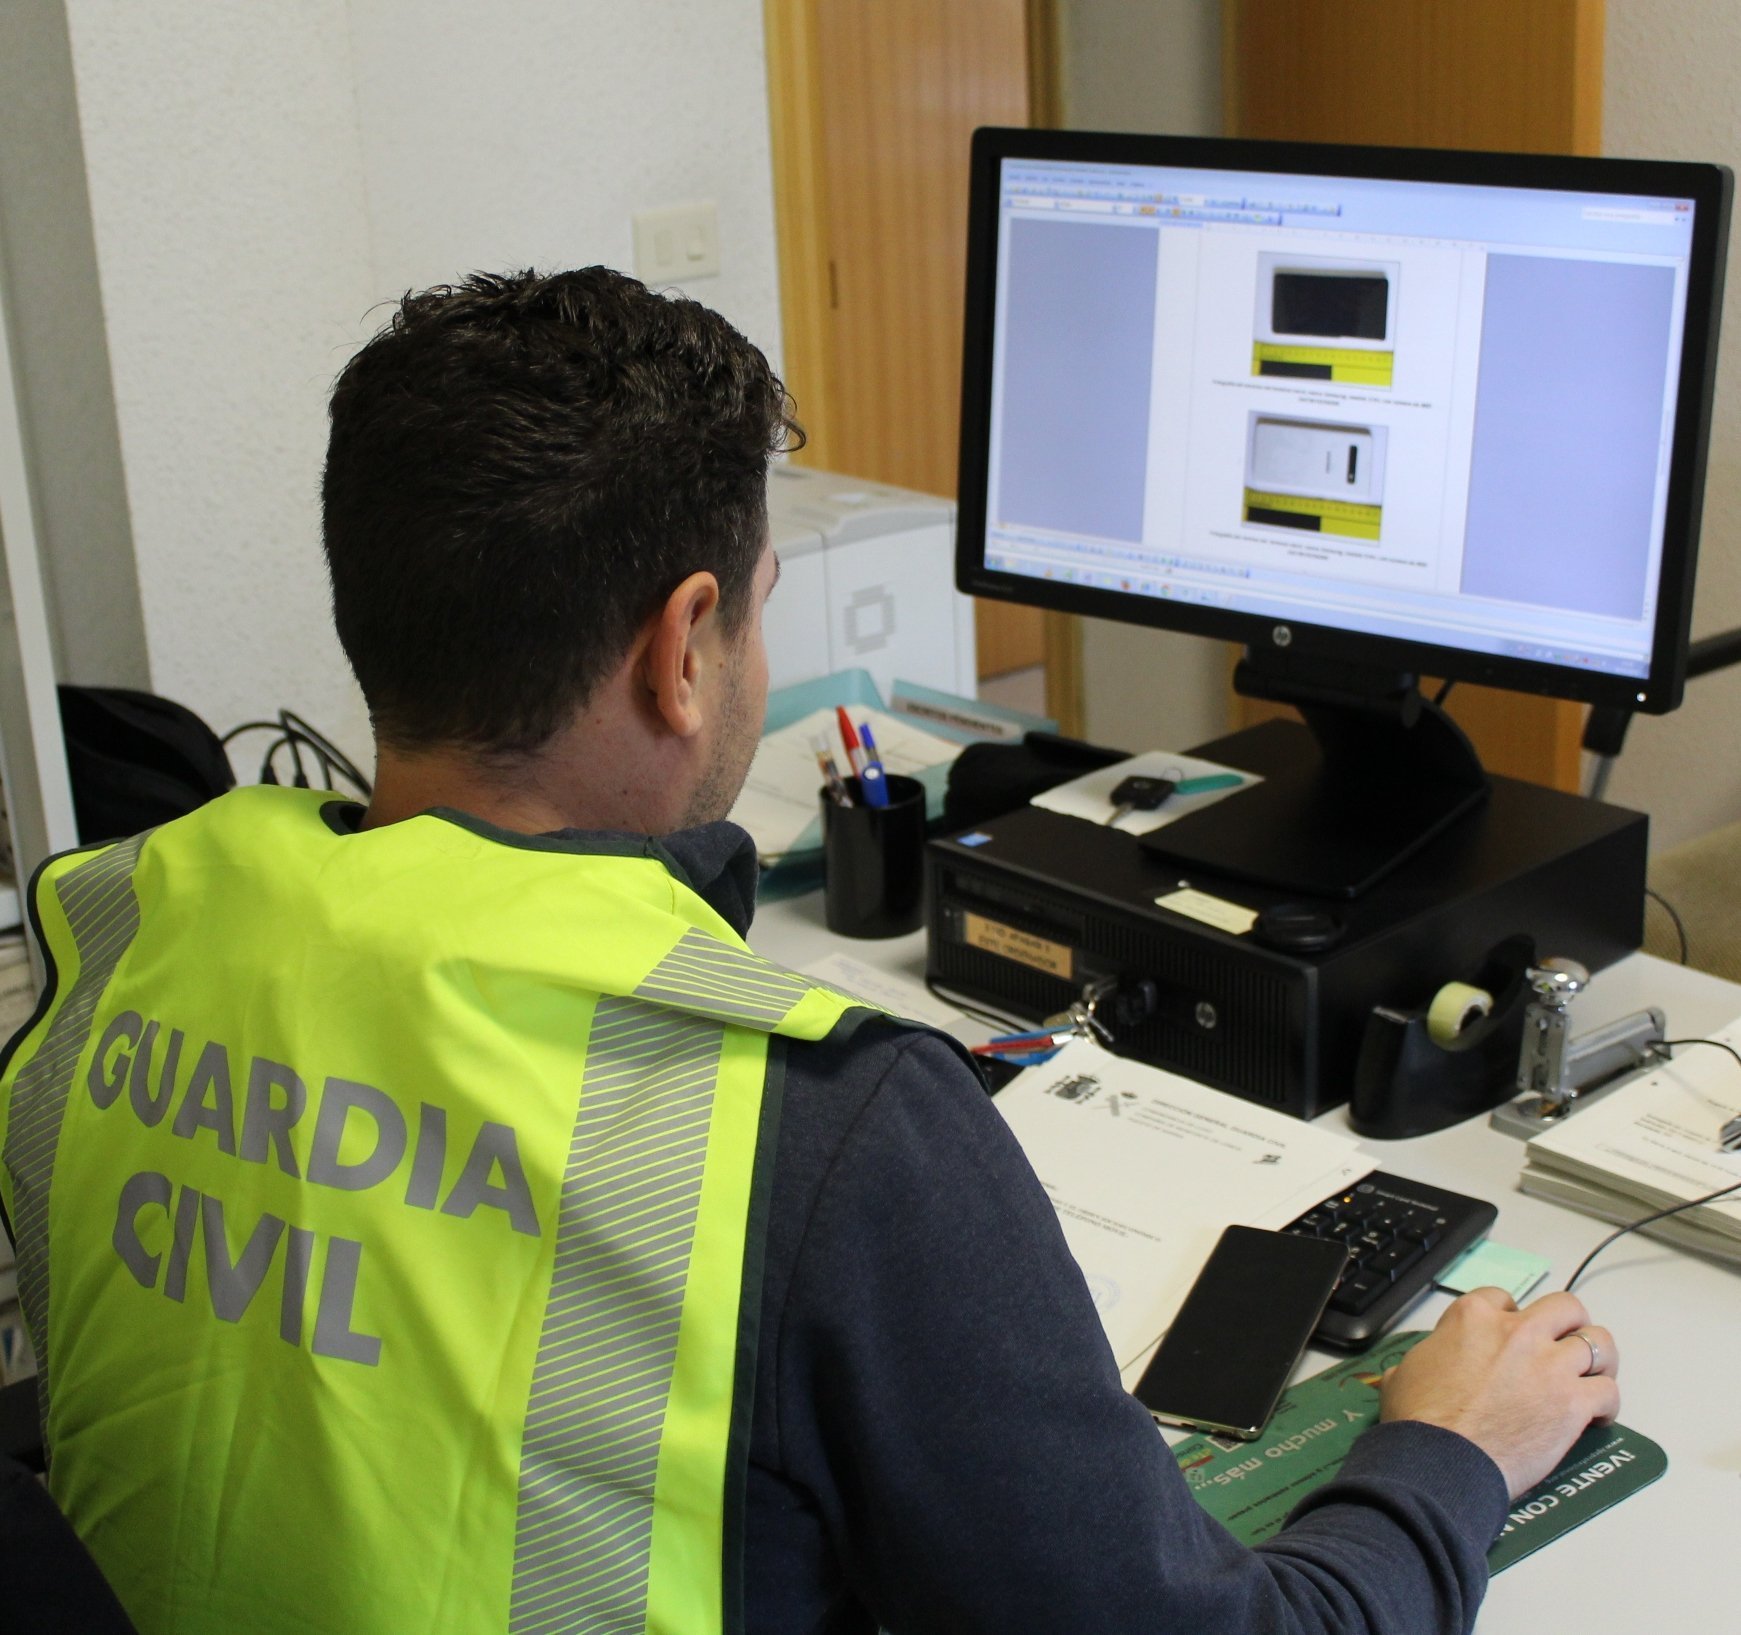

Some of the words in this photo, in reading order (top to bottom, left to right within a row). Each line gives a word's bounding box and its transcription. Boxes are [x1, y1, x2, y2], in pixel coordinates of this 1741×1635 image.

[87, 1010, 541, 1237] GUARDIA
[112, 1171, 381, 1366] CIVIL
[1342, 1409, 1365, 1422] Y
[1264, 1418, 1338, 1458] mucho
[1509, 1494, 1559, 1524] CON
